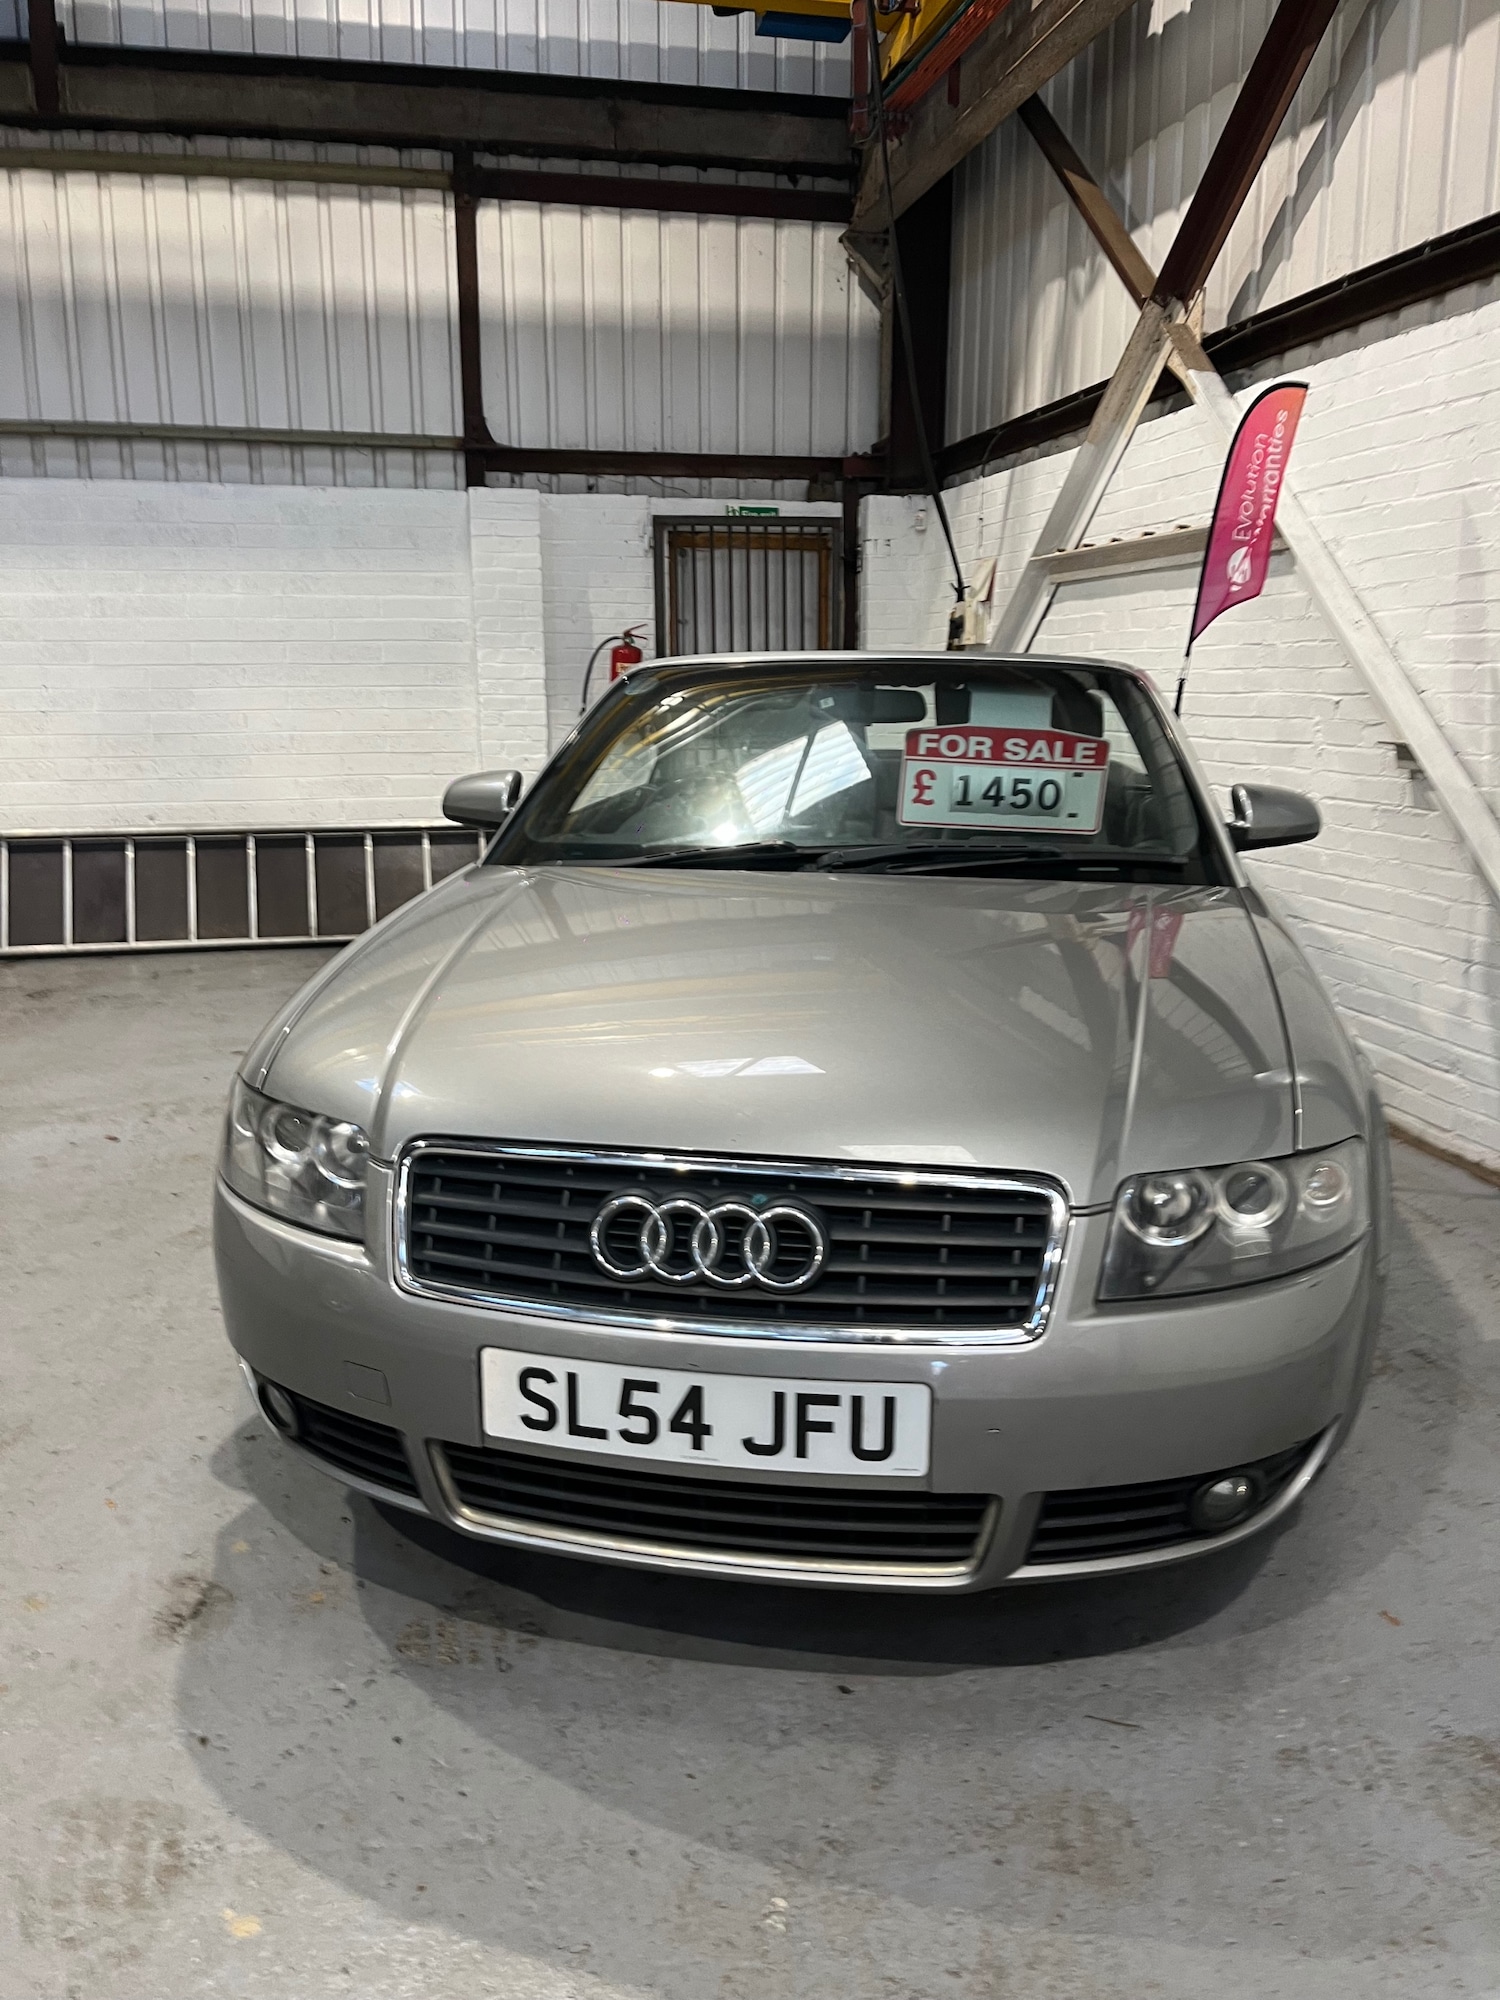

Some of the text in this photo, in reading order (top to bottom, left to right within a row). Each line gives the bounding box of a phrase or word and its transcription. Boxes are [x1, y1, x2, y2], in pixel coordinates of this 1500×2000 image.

[1232, 433, 1268, 541] Evolution
[916, 733, 1099, 764] FOR SALE
[911, 768, 1063, 811] £ 1450
[517, 1366, 898, 1462] SL54 JFU
